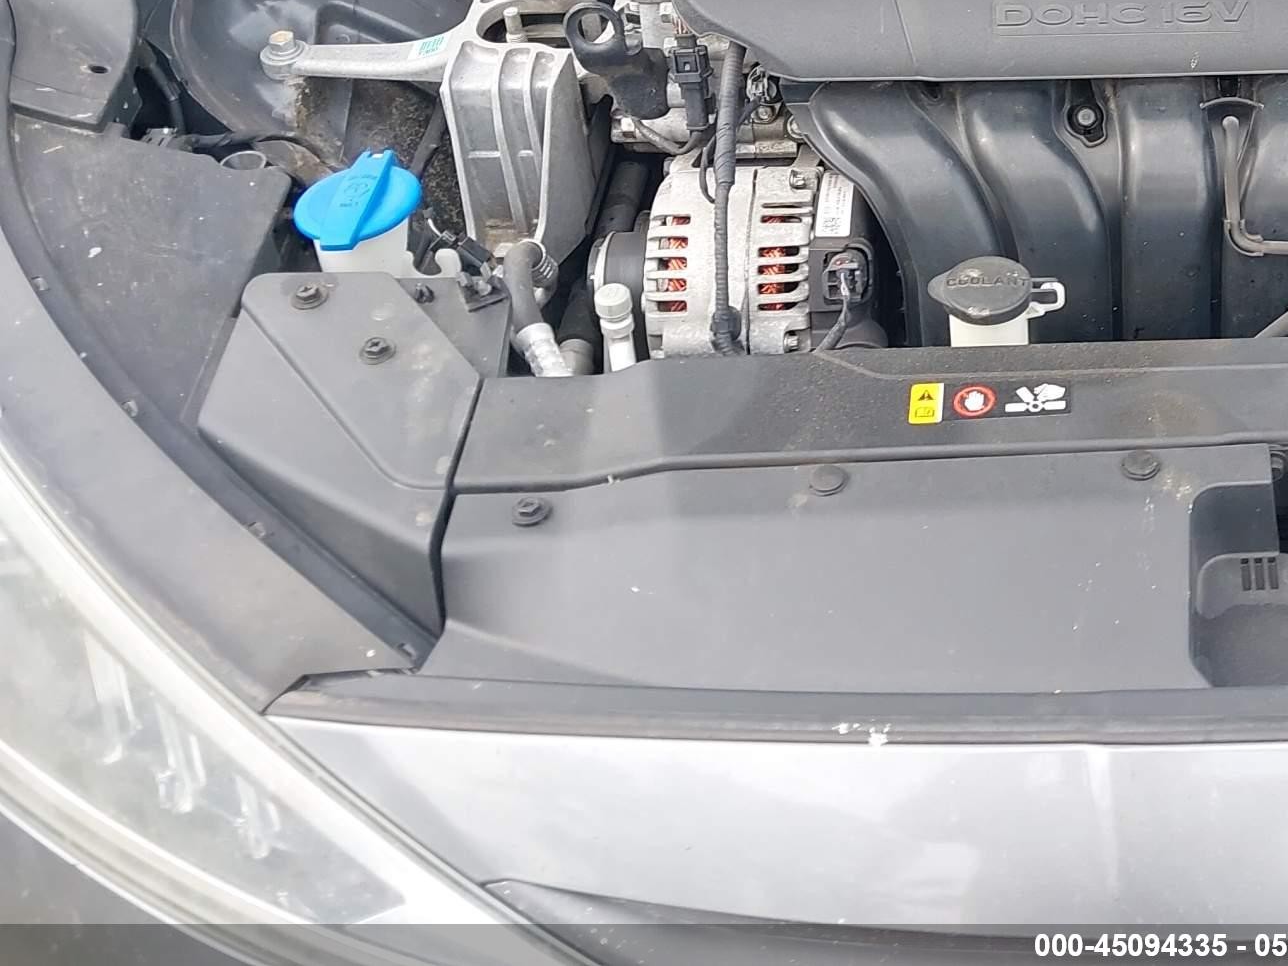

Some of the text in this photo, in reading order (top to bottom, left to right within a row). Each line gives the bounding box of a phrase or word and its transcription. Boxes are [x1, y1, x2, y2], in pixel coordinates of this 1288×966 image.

[996, 0, 1249, 27] DOHC 16V
[946, 276, 1030, 288] COOLANT
